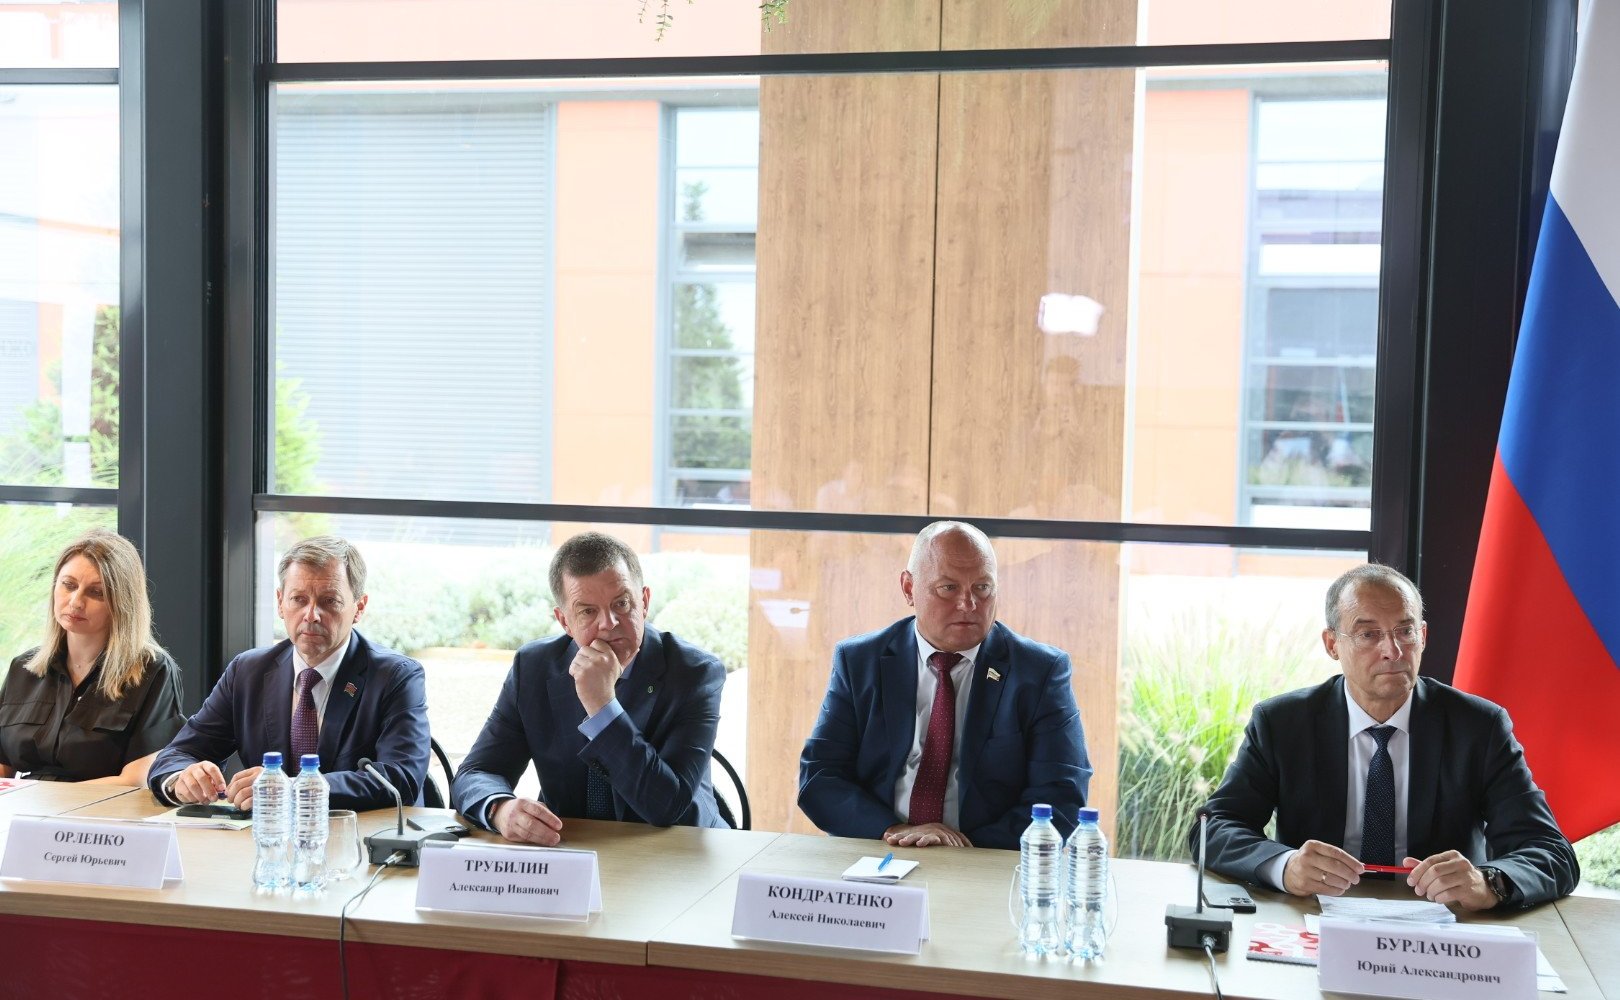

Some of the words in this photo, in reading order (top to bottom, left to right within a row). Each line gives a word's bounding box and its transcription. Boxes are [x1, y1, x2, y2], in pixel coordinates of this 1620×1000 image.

[54, 830, 125, 847] ОРЛЕНКО
[44, 851, 78, 864] Сергей
[80, 854, 127, 867] Юрьевич
[464, 859, 549, 875] ТРУБИЛИН
[449, 882, 504, 895] Александр
[507, 883, 560, 896] Иванович
[767, 885, 893, 909] КОНДРАТЕНКО
[768, 909, 814, 922] Алексей
[817, 914, 886, 930] Николаевич
[1376, 936, 1481, 959] БУРЛАЧКО
[1357, 960, 1397, 974] Юрий
[1400, 964, 1501, 984] Александрович
